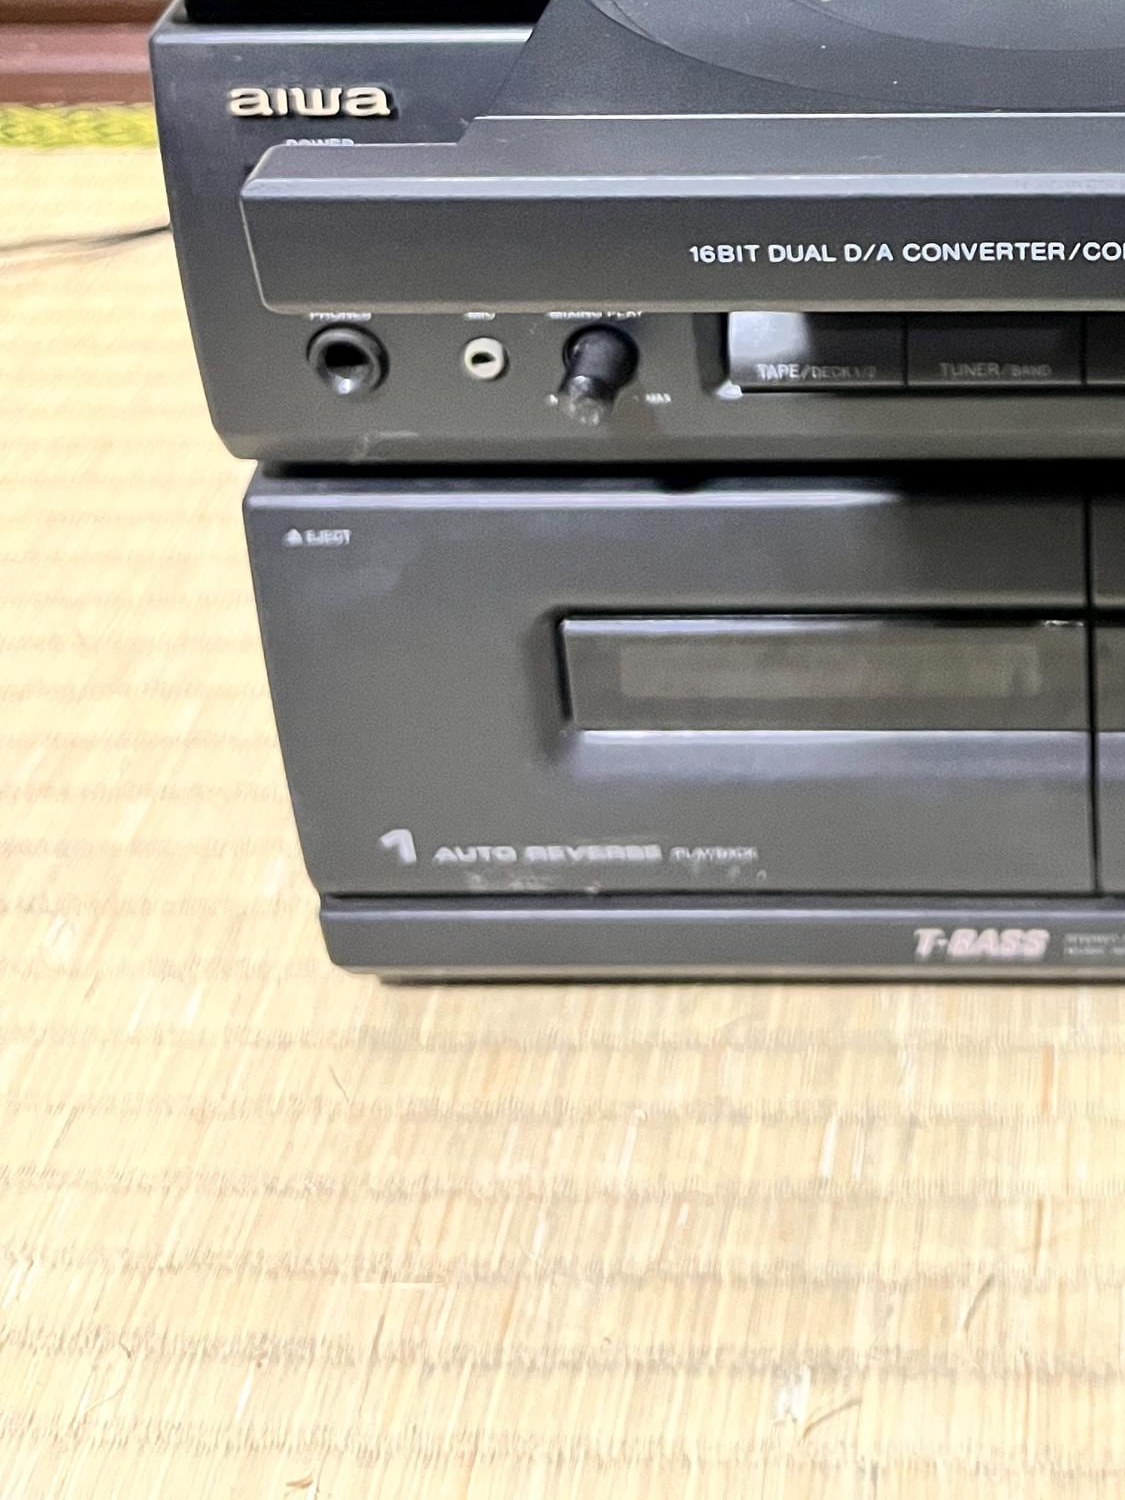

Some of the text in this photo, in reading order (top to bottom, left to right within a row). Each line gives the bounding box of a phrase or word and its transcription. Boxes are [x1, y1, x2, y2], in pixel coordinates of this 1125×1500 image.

[227, 87, 391, 116] aiwa
[689, 245, 760, 263] 16BIT
[768, 245, 835, 263] DUAL
[844, 245, 894, 263] D/A
[380, 828, 417, 863] 1
[433, 846, 517, 862] AUTO
[524, 844, 662, 862] REVERSE
[914, 928, 1050, 957] T-BASS
